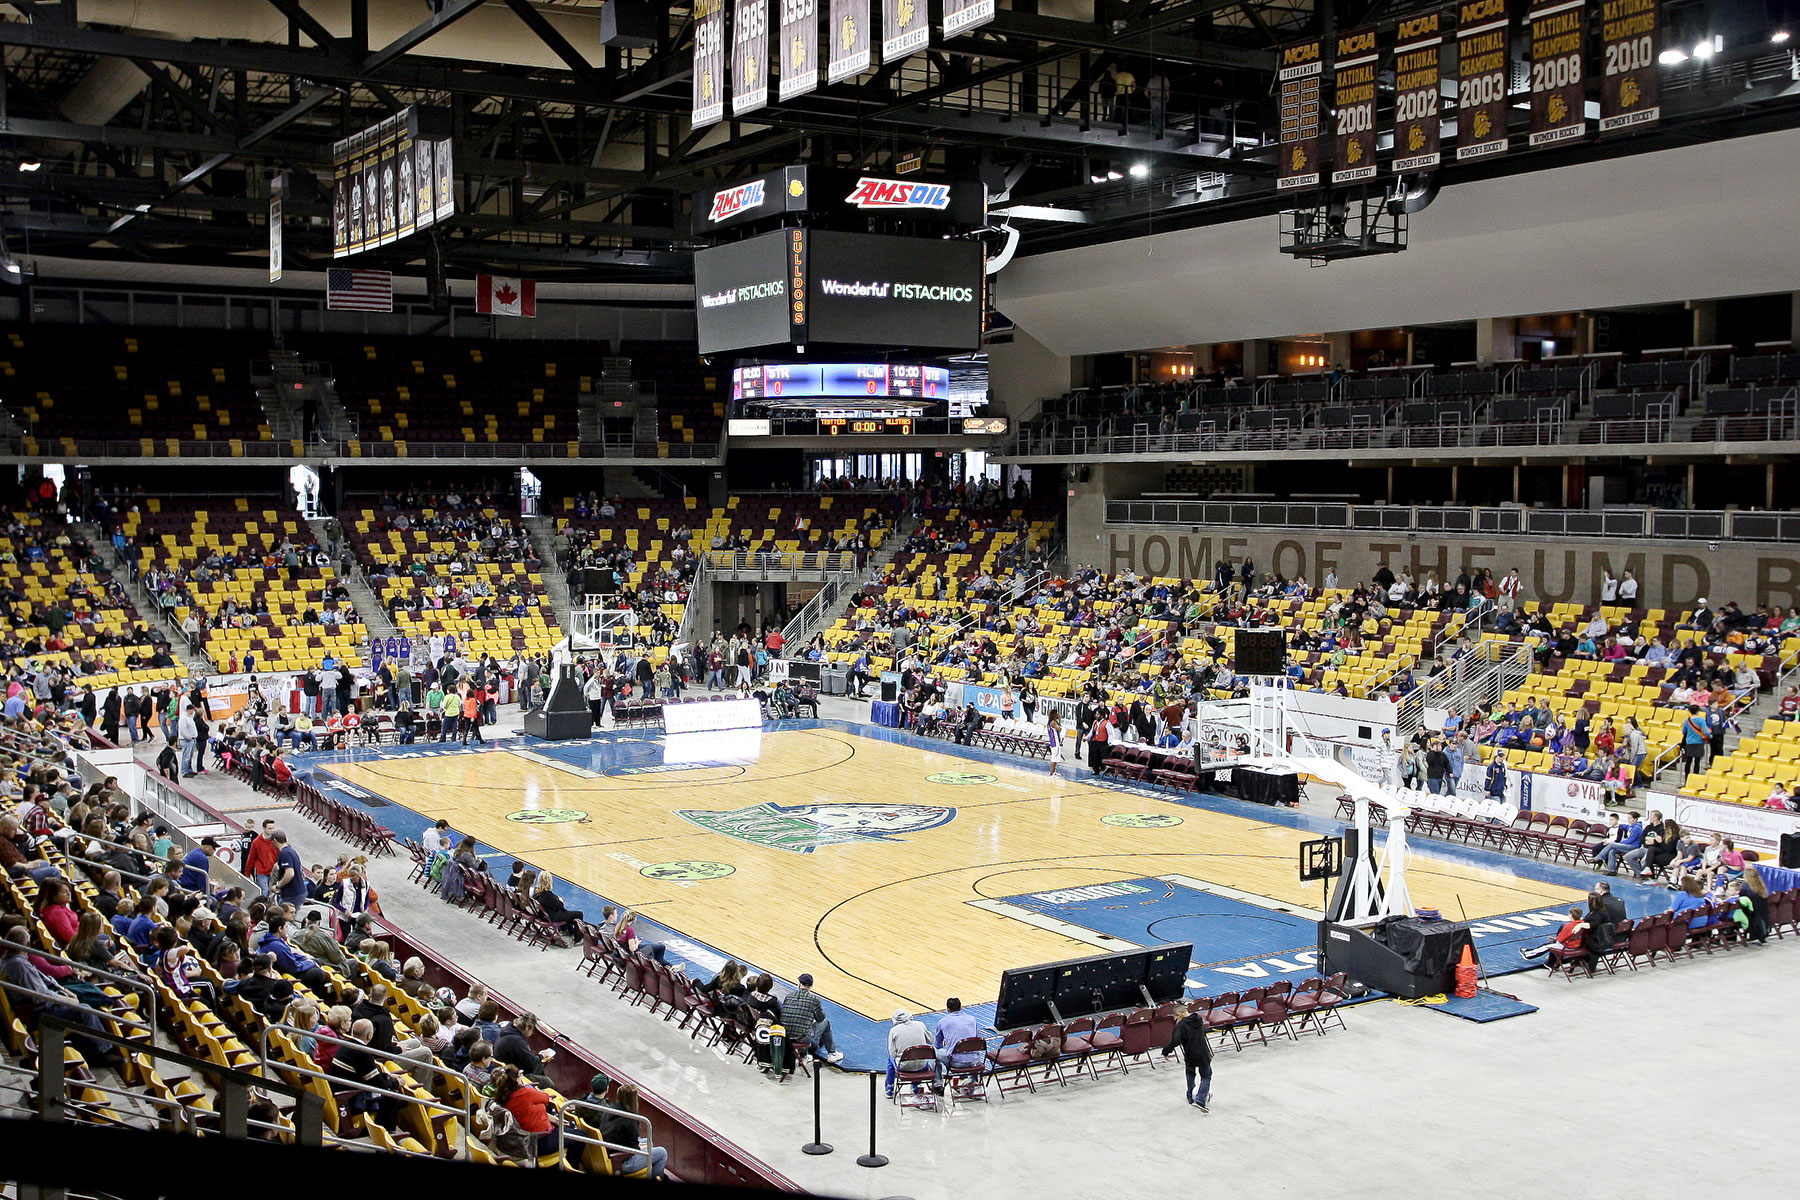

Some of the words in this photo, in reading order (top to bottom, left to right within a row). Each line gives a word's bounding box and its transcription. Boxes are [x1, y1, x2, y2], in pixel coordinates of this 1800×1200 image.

[967, 1, 990, 21] HOCKEY
[1460, 0, 1505, 24] NCAA
[1603, 0, 1655, 21] NATIONAL
[738, 2, 764, 45] 1985
[1397, 14, 1439, 40] NCAA
[1533, 11, 1581, 40] NATIONAL
[1603, 12, 1655, 42] CHAMPIONS
[695, 18, 720, 60] 1984
[903, 30, 925, 48] HOCKEY
[1337, 32, 1375, 56] NCAA
[1460, 31, 1504, 58] NATIONAL
[1533, 31, 1581, 60] CHAMPIONS
[1284, 43, 1319, 65] NCAA
[1397, 49, 1438, 73] NATIONAL
[1460, 51, 1504, 77] CHAMPIONS
[1605, 35, 1653, 76] 2010
[1283, 64, 1317, 79] TOURNAMENT
[1337, 65, 1375, 88] NATIONAL
[1396, 67, 1438, 92] CHAMPIONS
[1532, 54, 1581, 93] 2008
[1337, 83, 1374, 106] CHAMPIONS
[1459, 72, 1504, 109] 2003
[1396, 88, 1438, 123] 2002
[1337, 103, 1373, 136] 2001
[1604, 115, 1631, 129] WOMEN'S
[1631, 109, 1655, 123] HOCKEY
[1533, 130, 1559, 144] WOMEN'S
[1559, 126, 1580, 140] HOCKEY
[1460, 145, 1483, 158] WOMEN'S
[1483, 141, 1503, 155] HOCKEY
[1335, 169, 1355, 181] WOMEN'S
[1355, 167, 1373, 179] HOCKEY
[1395, 157, 1418, 170] WOMEN'S
[1417, 154, 1436, 168] HOCKEY
[708, 179, 765, 223] AMSOIL
[845, 177, 951, 210] AMSOIL
[793, 230, 805, 324] BULLDOGS
[702, 288, 736, 308] Wonderful
[738, 280, 785, 303] PISTACHIOS
[821, 278, 890, 298] Wonderful
[893, 284, 973, 303] PISTACHIOS
[893, 366, 920, 378] 10:00
[773, 381, 783, 395] 0
[866, 379, 877, 394] 0
[929, 383, 937, 397] 0
[831, 425, 838, 435] 0
[853, 421, 876, 432] 10:00
[902, 425, 909, 435] 0
[1109, 533, 1248, 581] HOME
[1272, 539, 1342, 588] OF
[1369, 543, 1496, 588] THE
[1533, 549, 1711, 609] UMD
[1756, 557, 1800, 613] B
